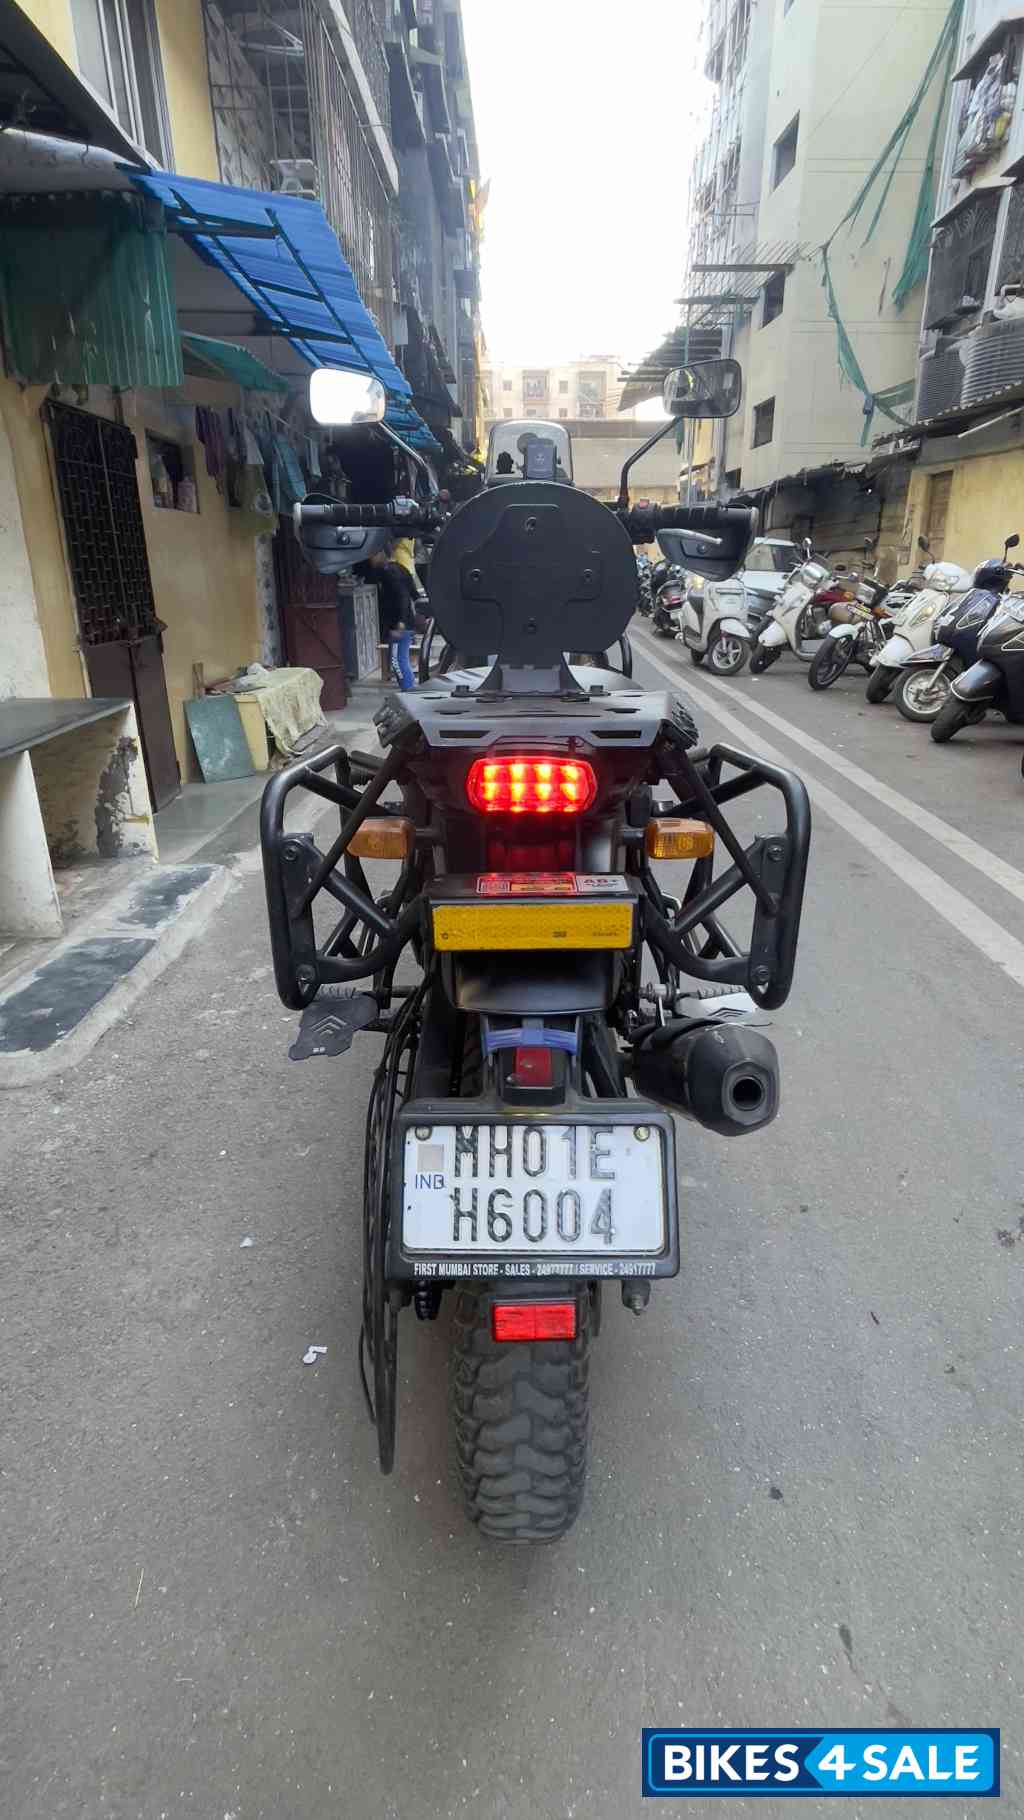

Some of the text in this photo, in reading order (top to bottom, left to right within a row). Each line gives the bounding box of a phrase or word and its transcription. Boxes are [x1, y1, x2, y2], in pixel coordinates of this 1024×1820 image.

[454, 1126, 615, 1179] MH01E
[415, 1174, 445, 1190] IND
[453, 1187, 616, 1245] H6004
[414, 1263, 437, 1275] FIRST
[438, 1263, 470, 1275] MUMBAI
[472, 1263, 499, 1275] STORE
[505, 1263, 530, 1275] SALES
[579, 1263, 613, 1276] SERVICE
